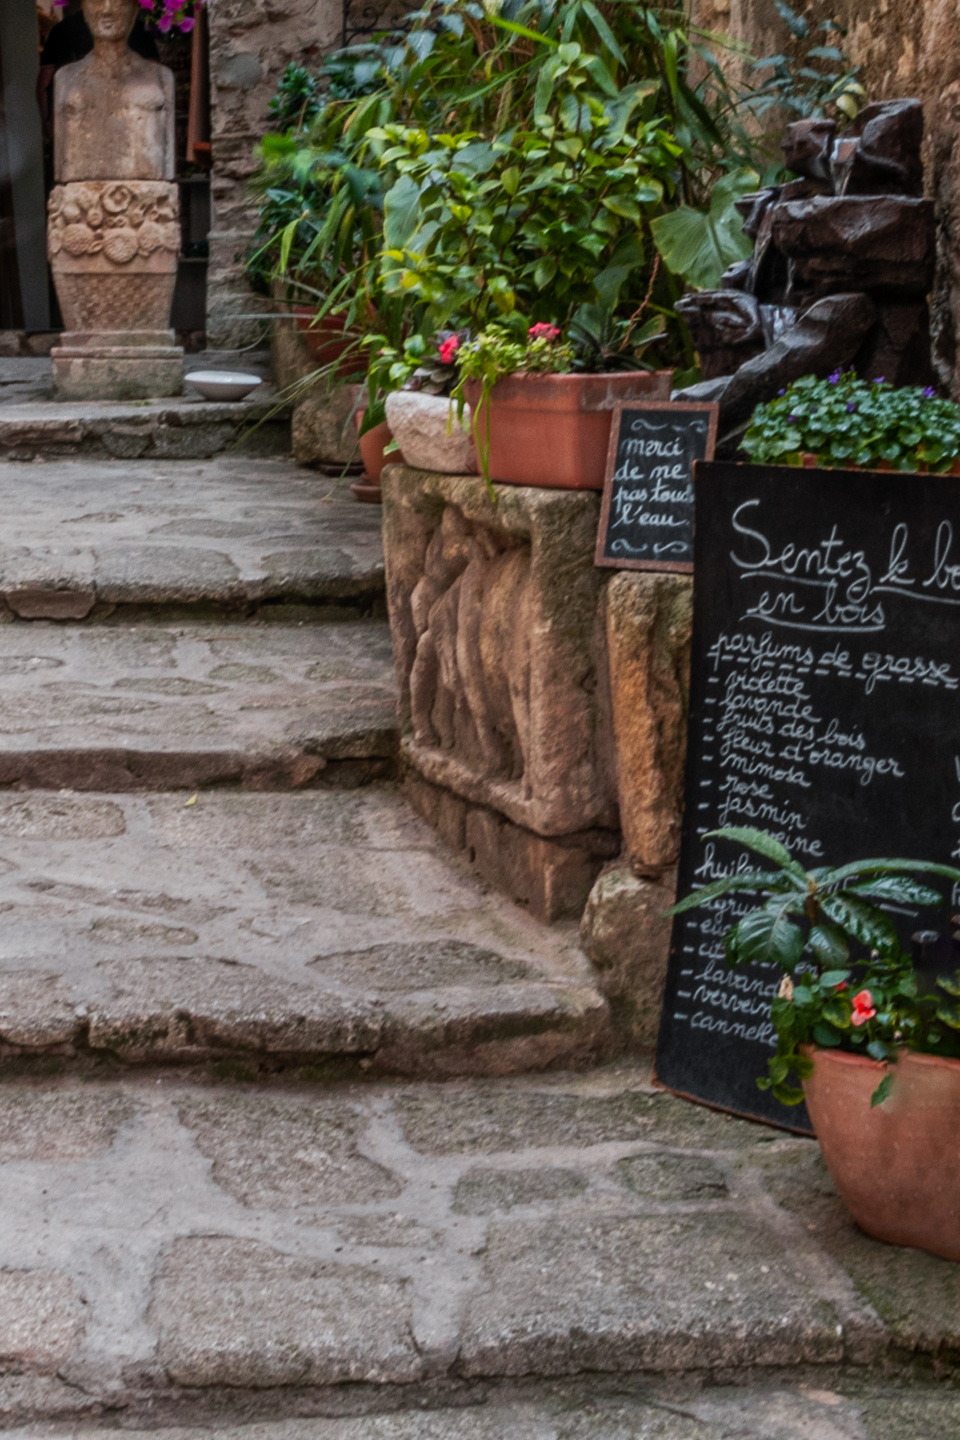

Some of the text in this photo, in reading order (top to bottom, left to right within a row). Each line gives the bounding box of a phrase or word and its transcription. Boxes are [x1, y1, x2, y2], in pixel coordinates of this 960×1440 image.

[619, 437, 685, 457] merci
[611, 459, 689, 481] de ne
[611, 485, 648, 514] pas
[729, 498, 872, 604] Sentez
[879, 522, 916, 584] le
[746, 577, 886, 624] en bois
[710, 630, 959, 695] parfums de grasse
[724, 670, 810, 700] violette
[718, 687, 822, 723] lavande
[720, 727, 775, 756] fleur
[778, 719, 815, 741] des
[816, 718, 866, 751] bois
[718, 774, 775, 800] rose
[720, 753, 812, 787] mimosa
[717, 790, 807, 829] jasmin
[693, 959, 782, 997] lavand
[692, 984, 773, 1020] vervein
